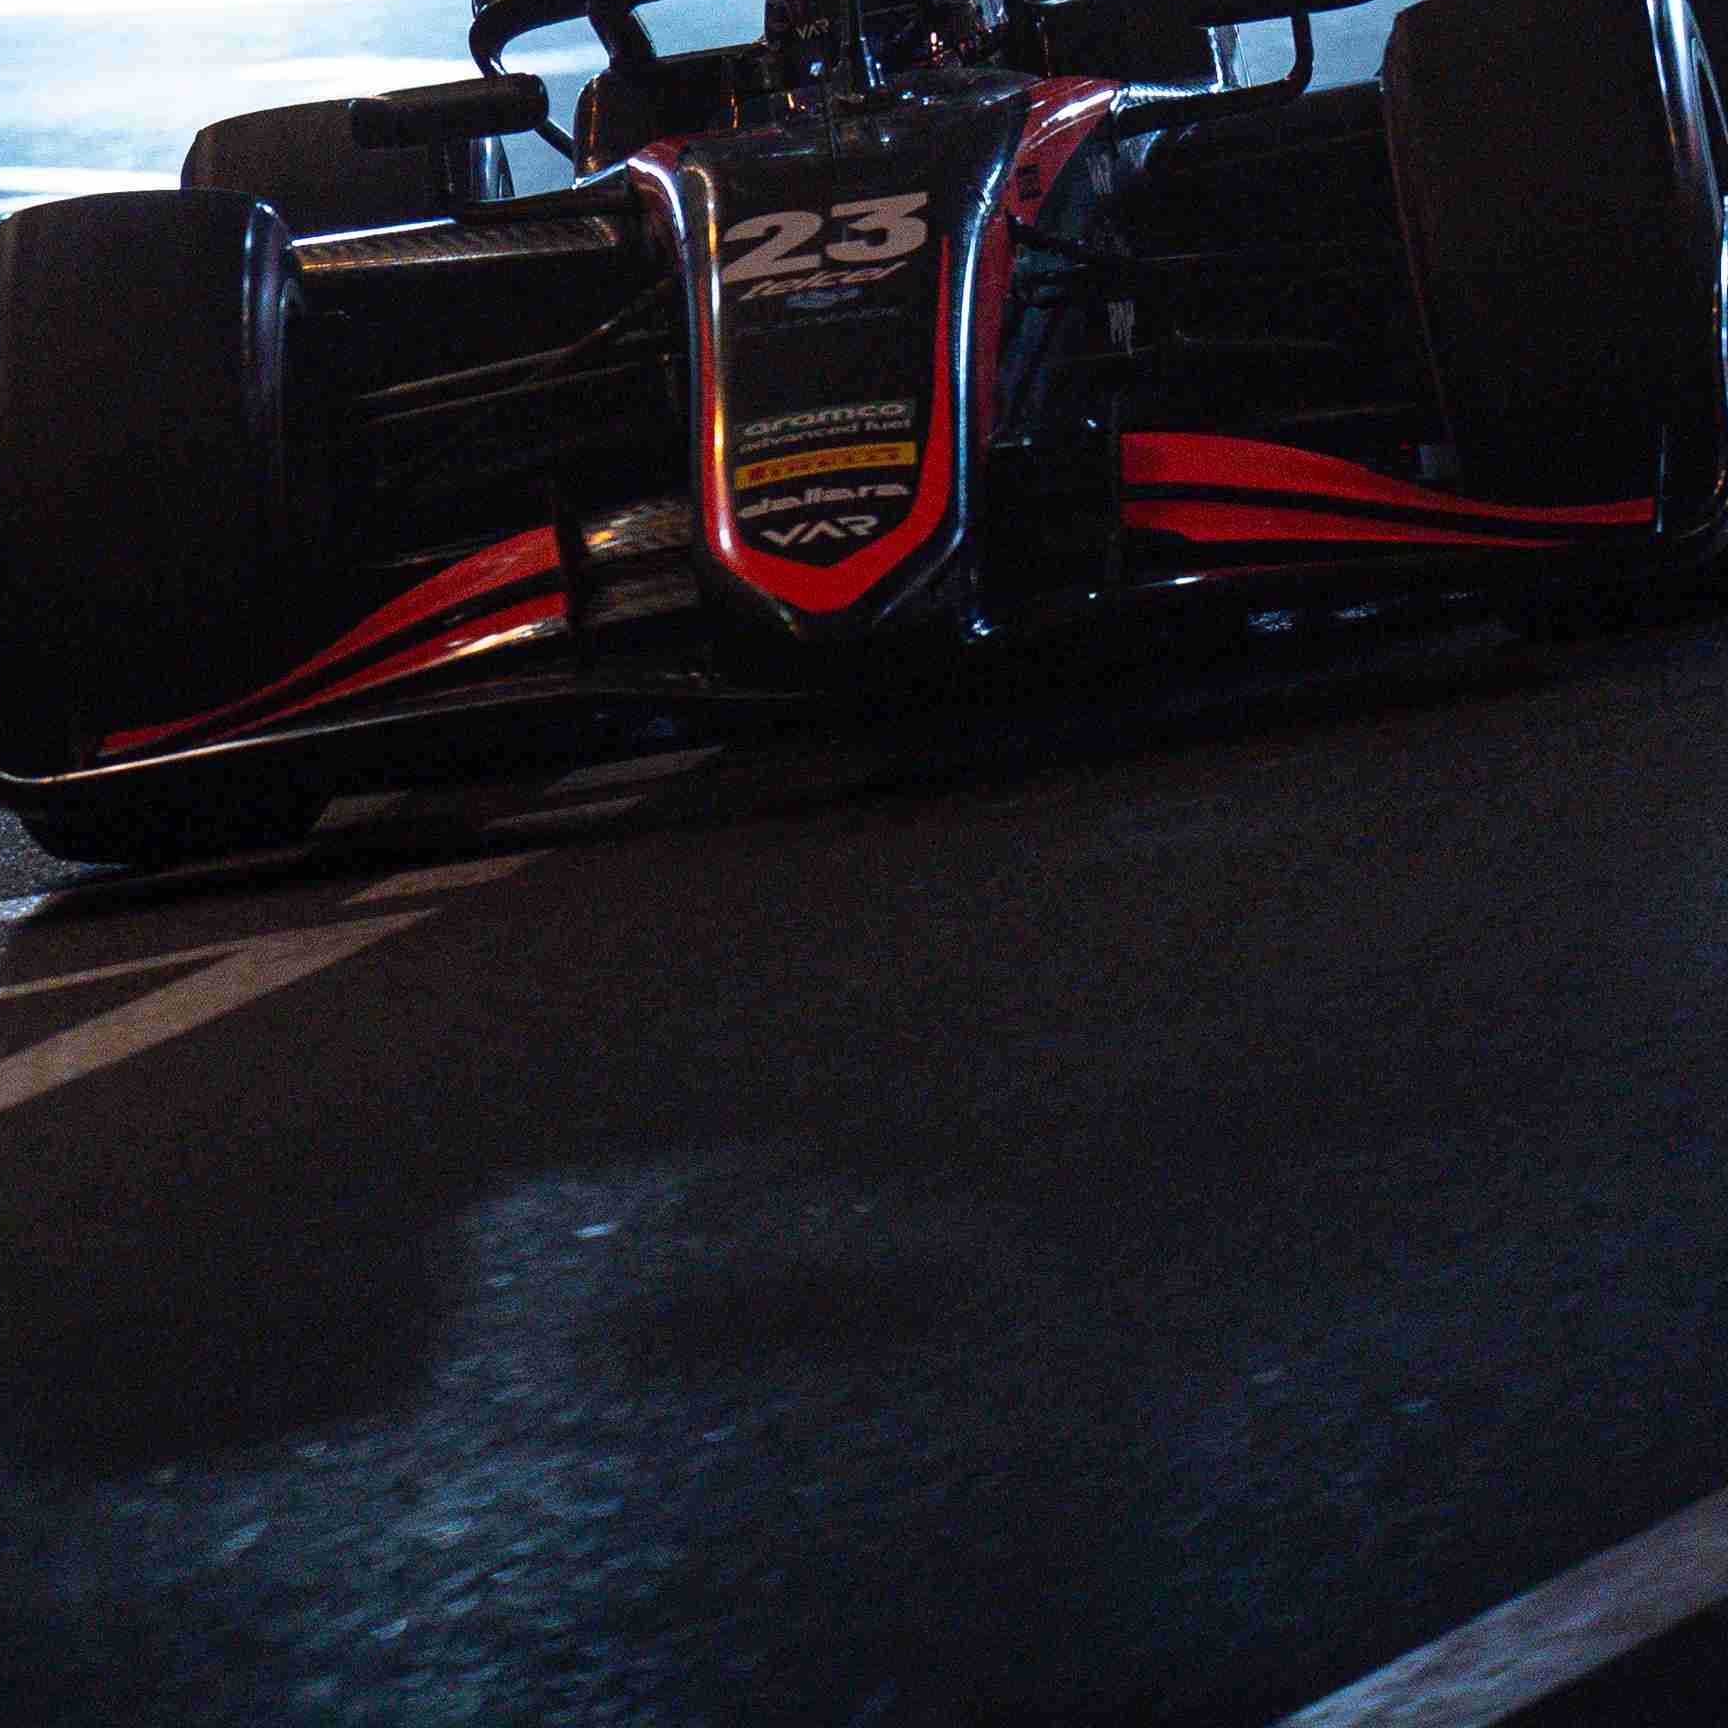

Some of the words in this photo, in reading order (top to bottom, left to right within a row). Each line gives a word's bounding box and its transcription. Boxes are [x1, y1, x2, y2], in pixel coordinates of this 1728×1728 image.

[718, 191, 929, 284] 23
[744, 403, 906, 435] aramco
[760, 515, 879, 547] VAR
